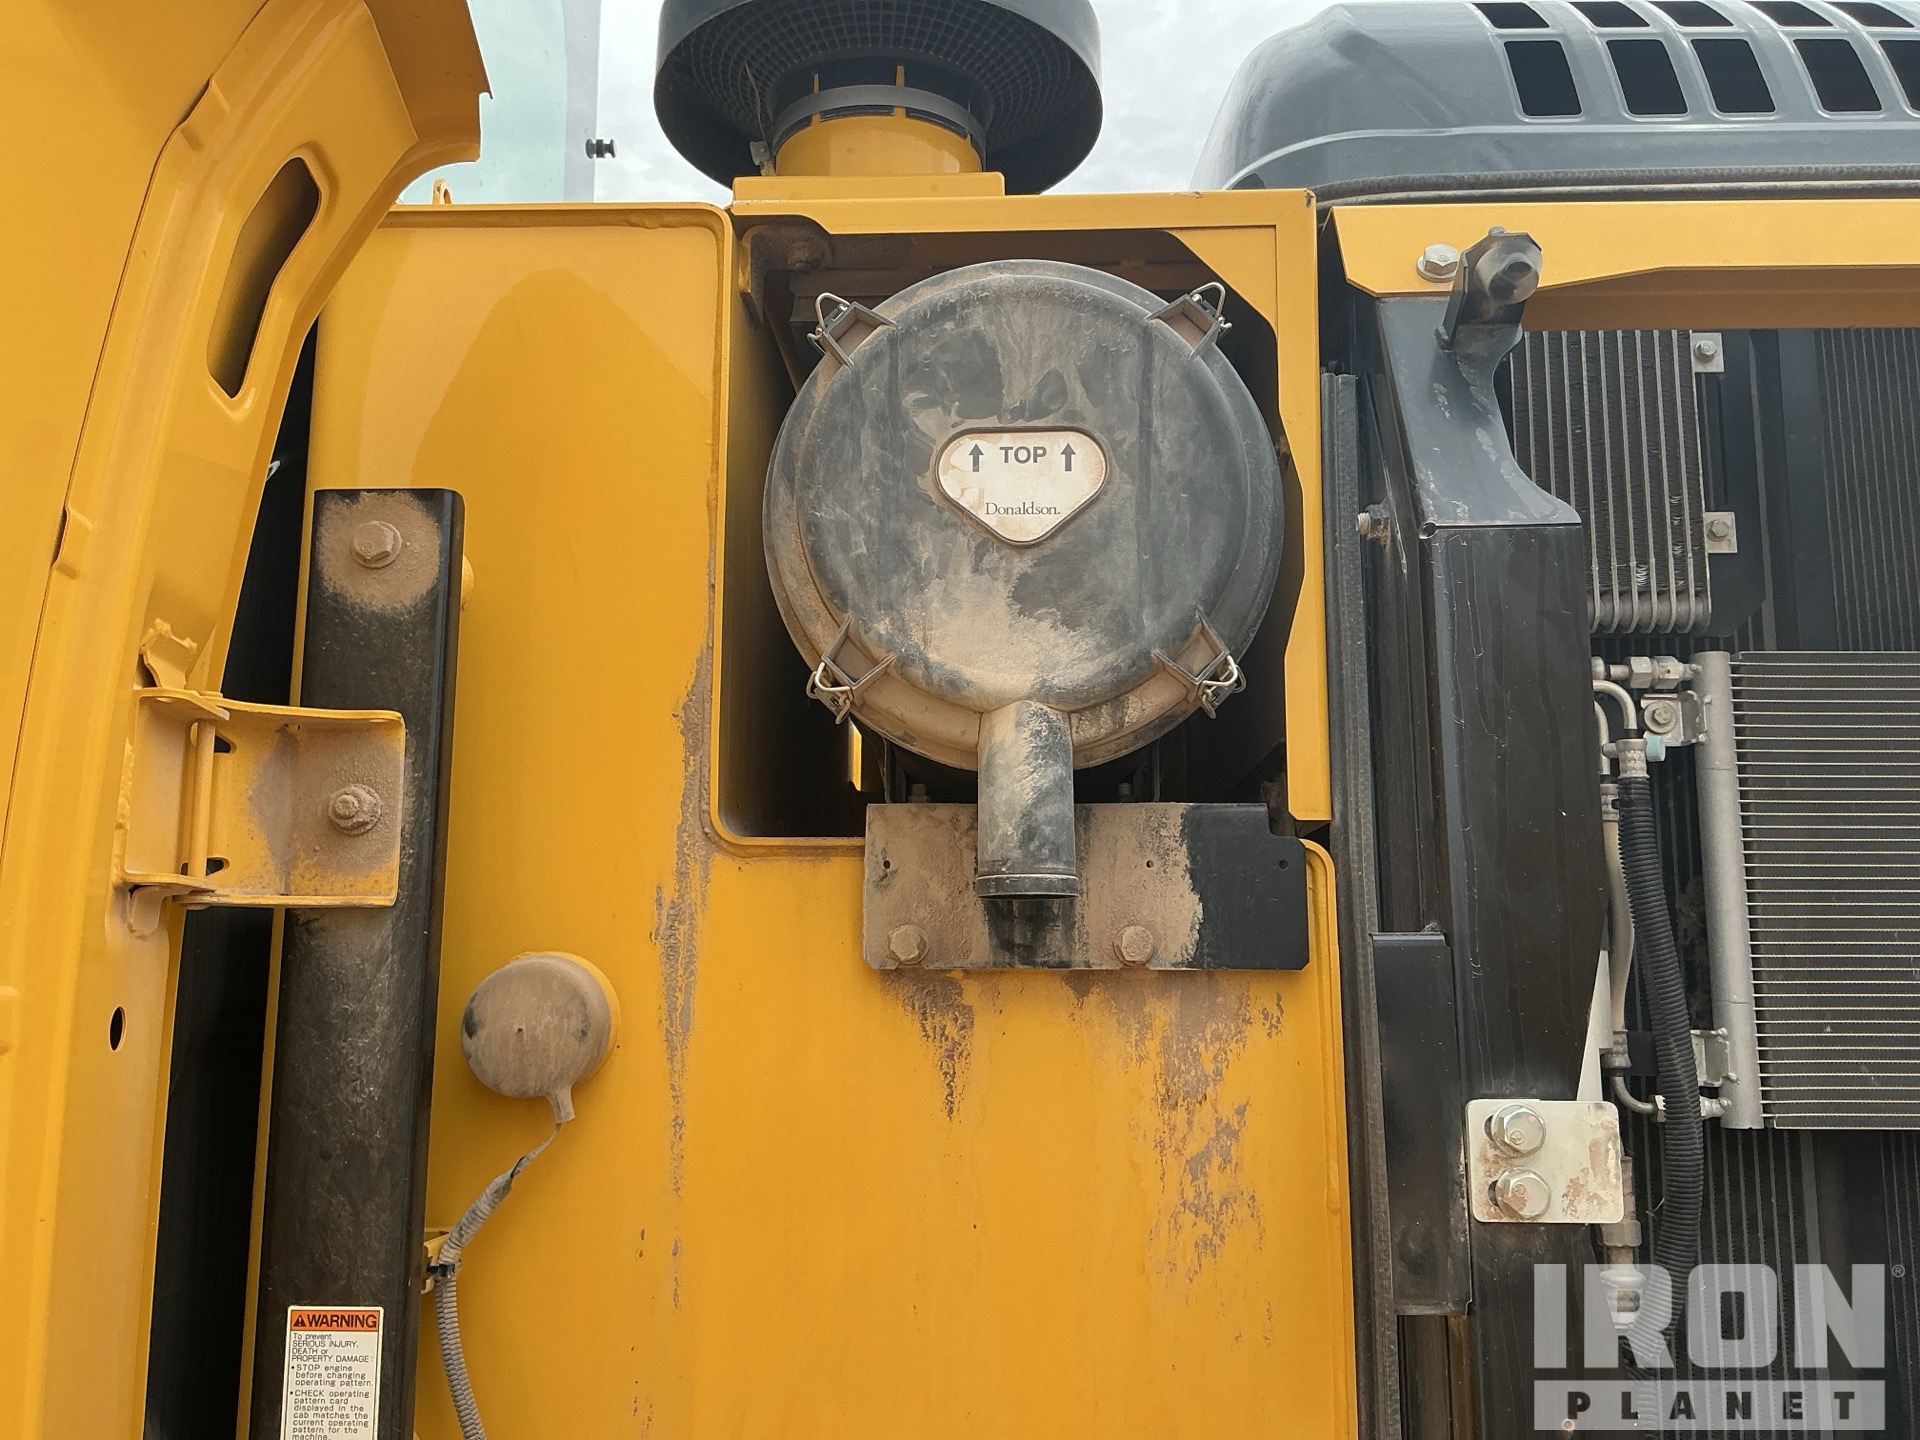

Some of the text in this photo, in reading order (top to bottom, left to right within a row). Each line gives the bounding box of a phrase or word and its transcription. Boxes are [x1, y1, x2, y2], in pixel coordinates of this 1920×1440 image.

[999, 446, 1048, 464] TOP
[307, 1314, 377, 1328] WARNING
[327, 1372, 366, 1380] changing
[329, 1390, 369, 1398] operating
[328, 1420, 368, 1428] operating
